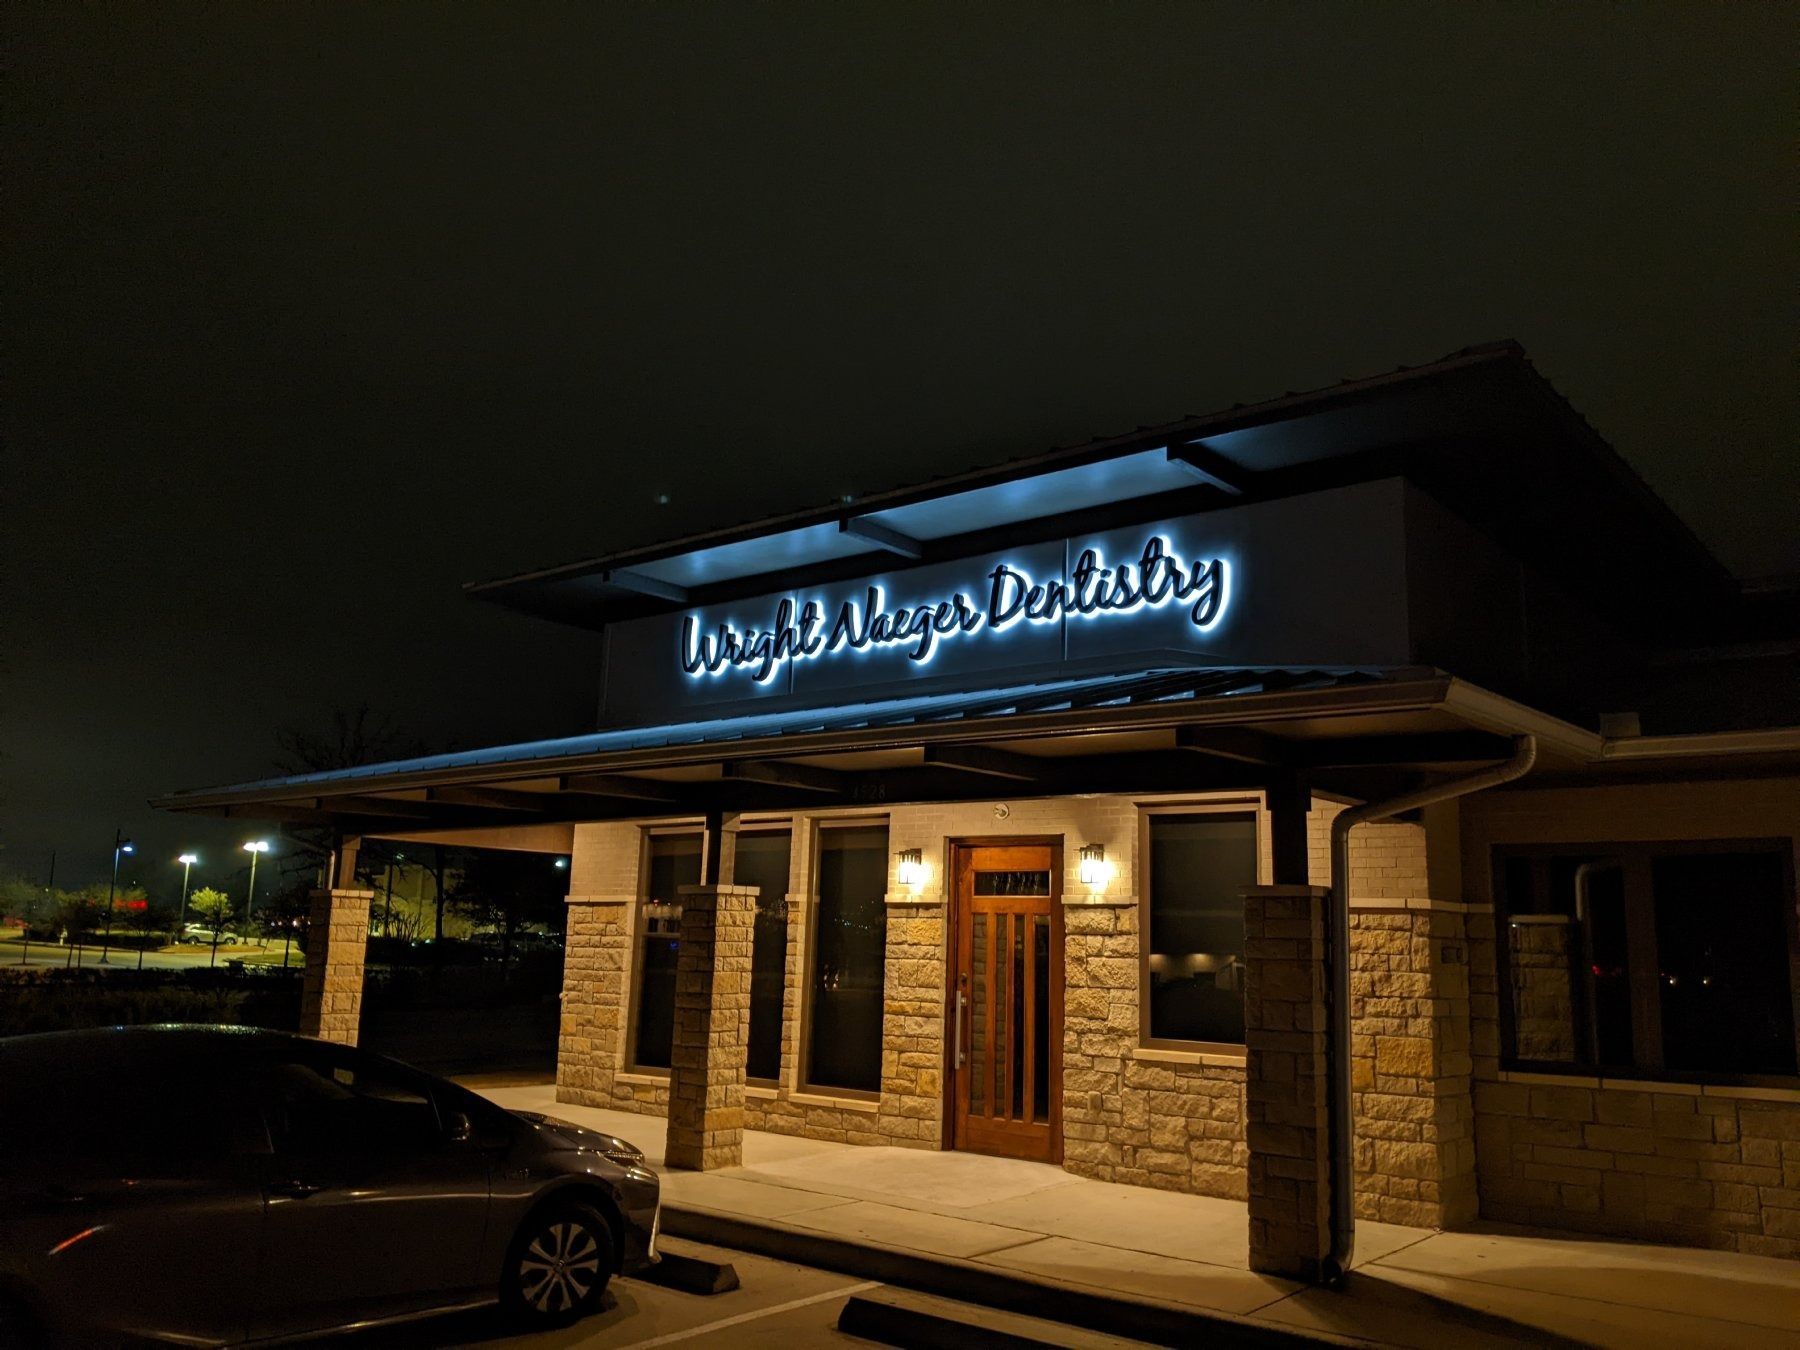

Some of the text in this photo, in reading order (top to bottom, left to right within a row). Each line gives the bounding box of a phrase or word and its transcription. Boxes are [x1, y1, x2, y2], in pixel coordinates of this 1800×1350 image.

[682, 536, 1224, 682] Wright Naeger Dentistry
